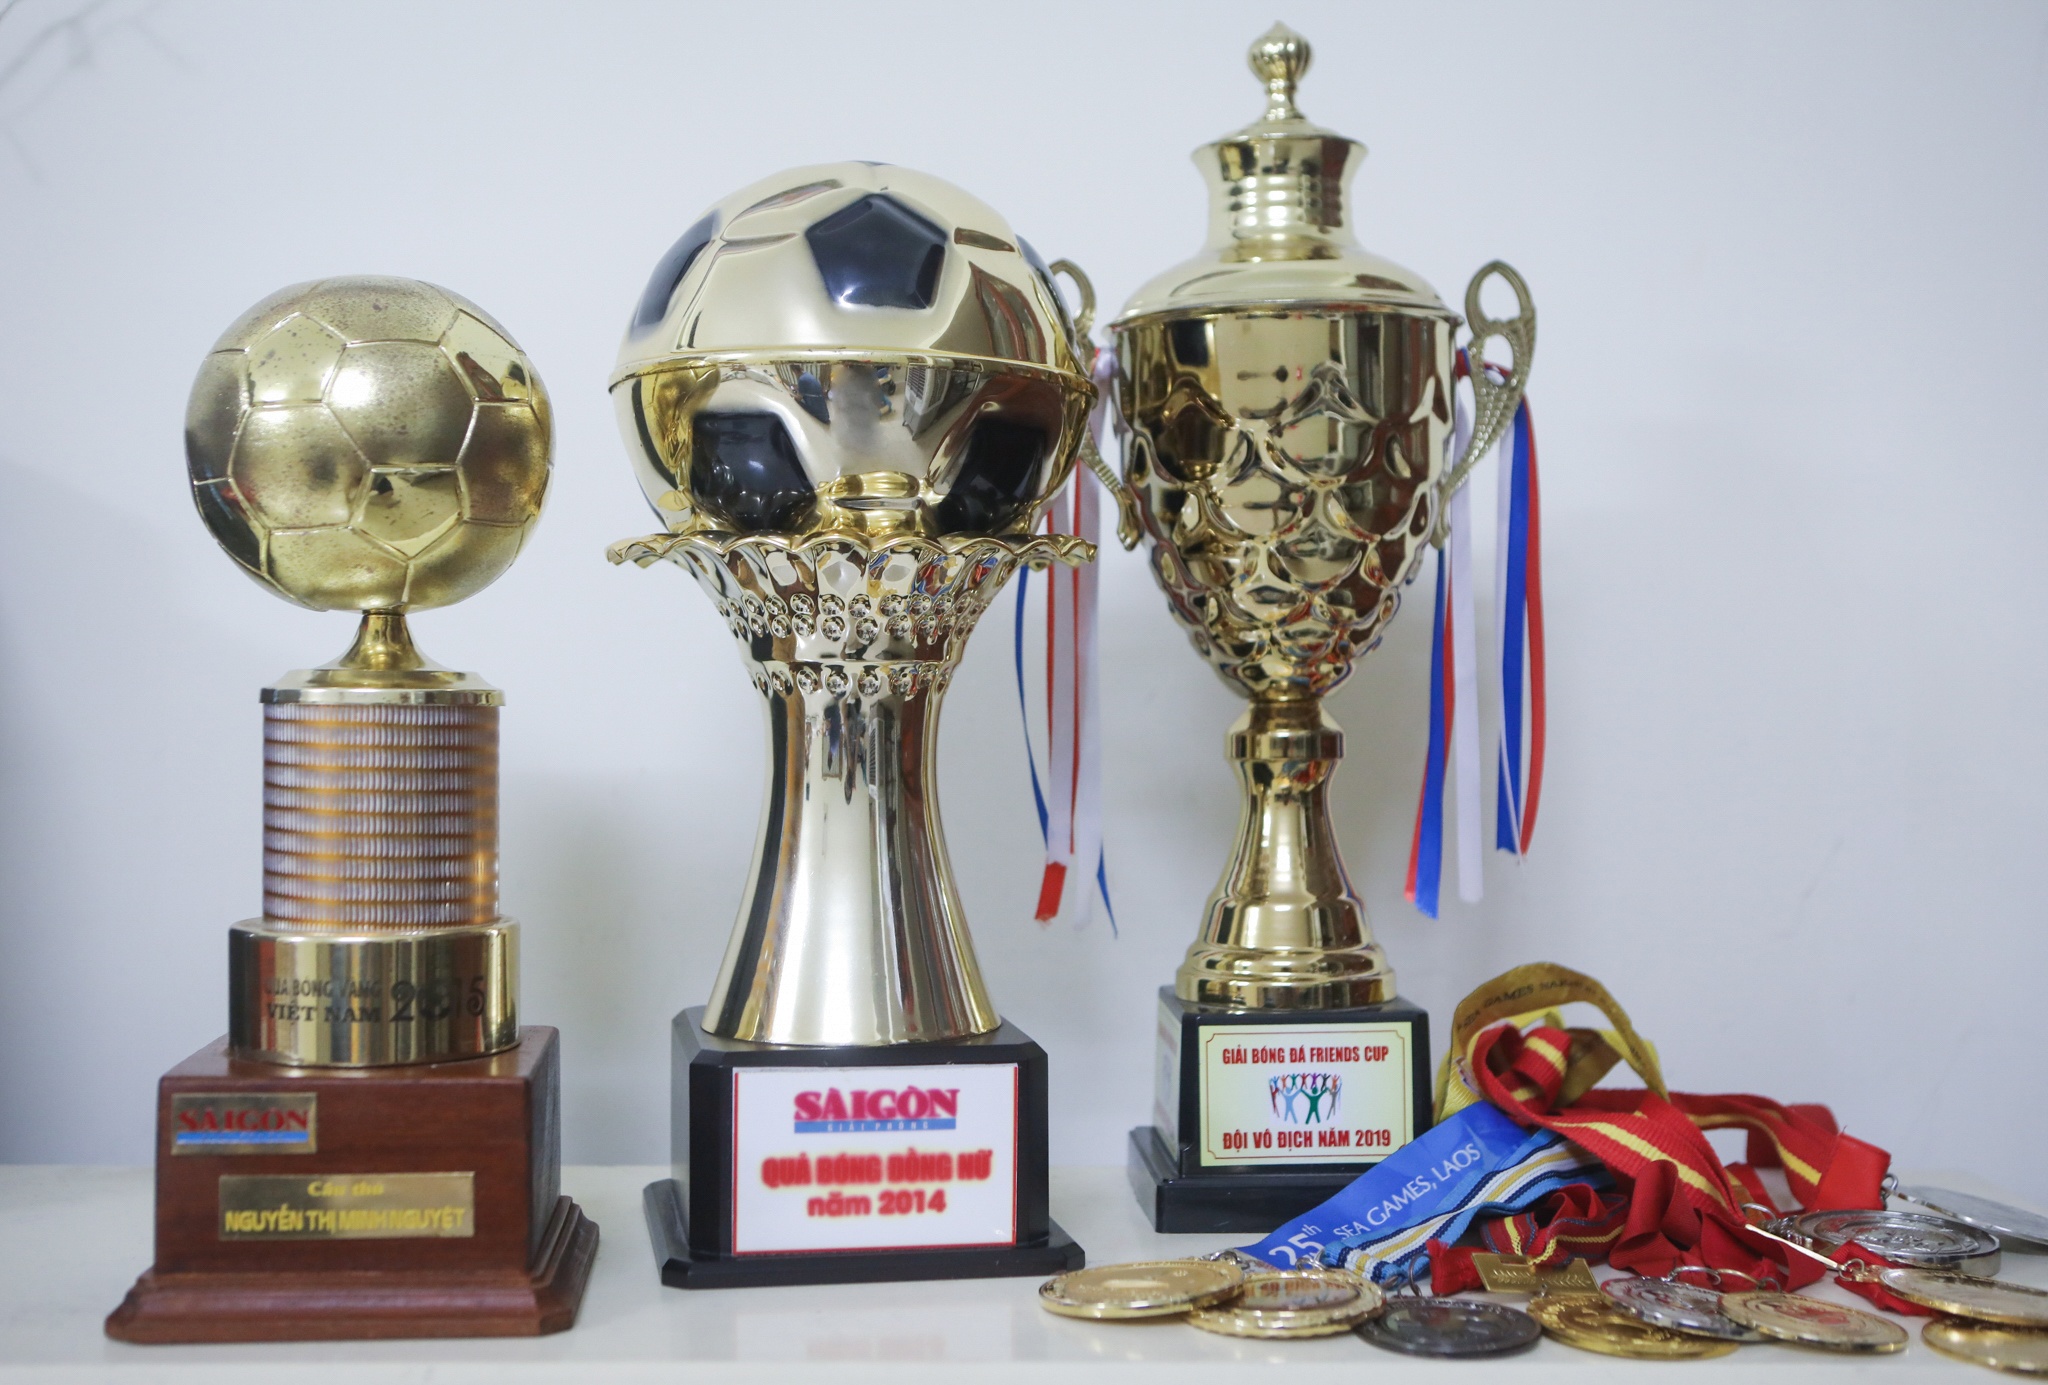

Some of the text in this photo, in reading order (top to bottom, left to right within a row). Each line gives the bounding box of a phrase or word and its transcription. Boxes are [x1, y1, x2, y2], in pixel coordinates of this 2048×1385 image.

[266, 999, 316, 1025] VIỆT
[323, 1005, 381, 1023] NAM
[1222, 1043, 1389, 1064] GIẢI BÓNG ĐÁ FRIENDS CUP
[794, 1085, 960, 1120] SÀIGÒN
[1222, 1127, 1392, 1153] ĐỘI VÔ ĐỊCH NĂM 2019
[762, 1152, 812, 1188] QUẢ
[815, 1153, 883, 1186] BÓNG
[807, 1190, 947, 1217] năm 2014
[1333, 1222, 1367, 1241] SEA
[1366, 1174, 1438, 1226] GAMES,
[1431, 1142, 1483, 1182] LAOS
[338, 1210, 387, 1232] MINH
